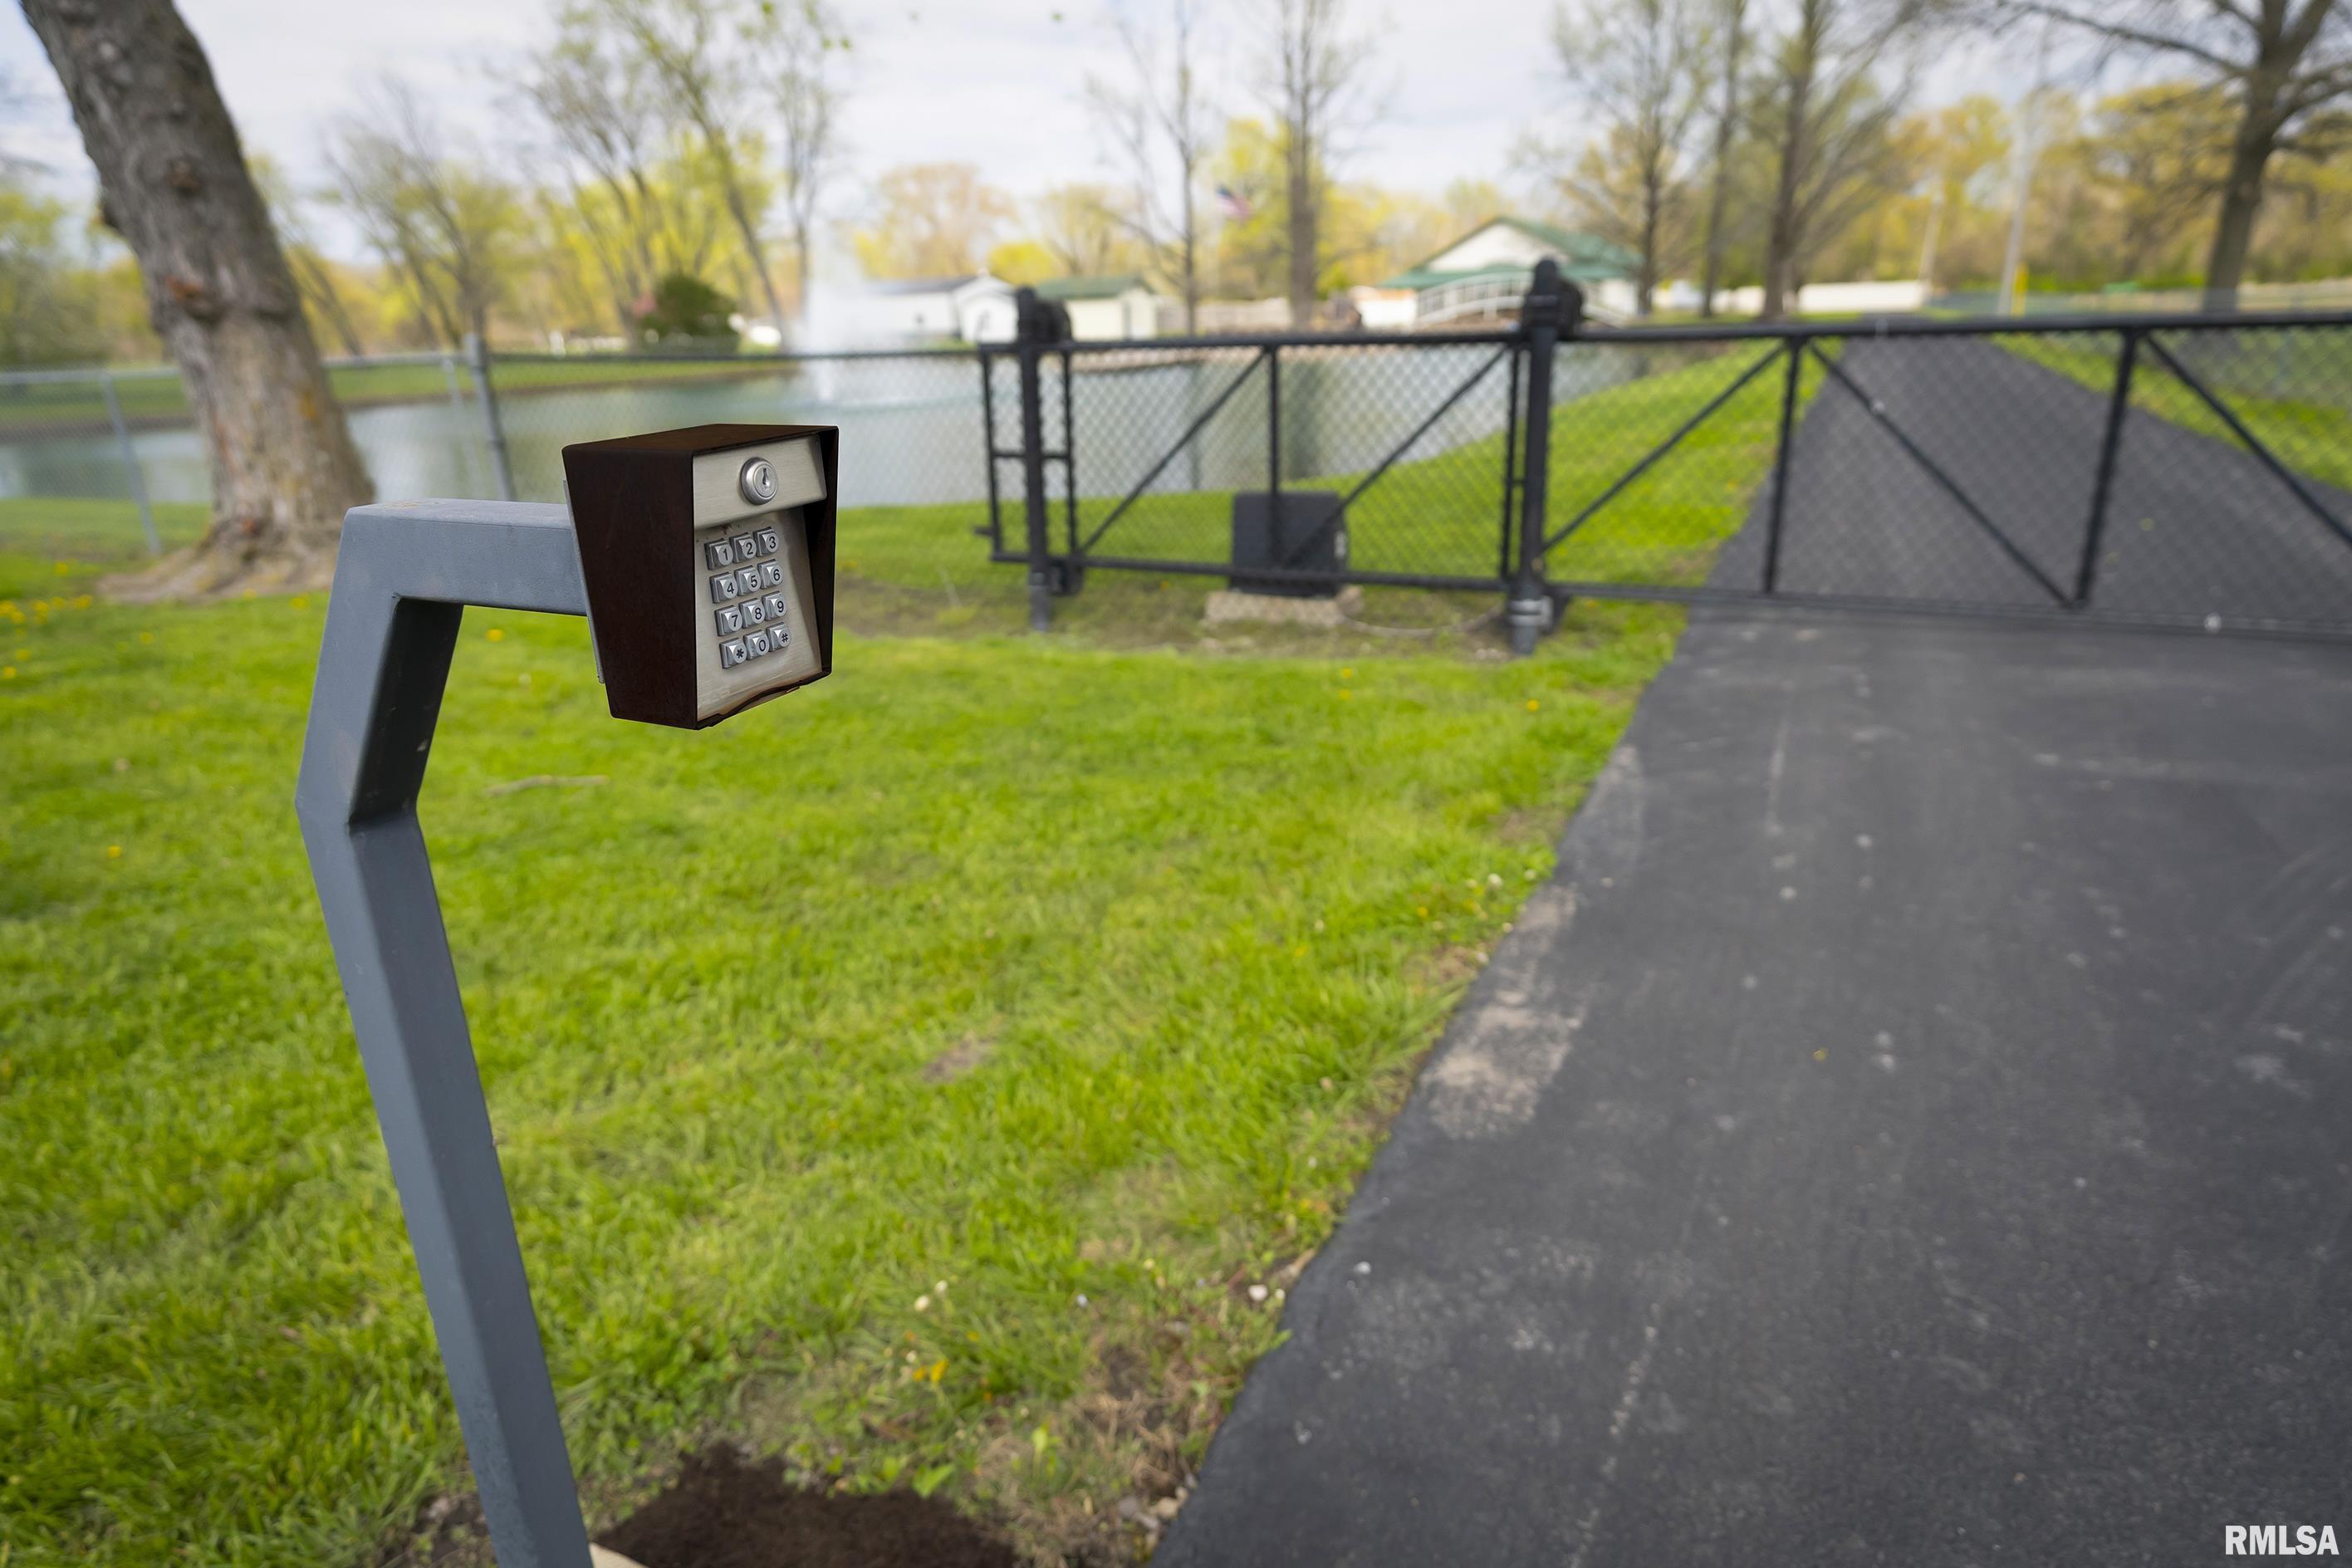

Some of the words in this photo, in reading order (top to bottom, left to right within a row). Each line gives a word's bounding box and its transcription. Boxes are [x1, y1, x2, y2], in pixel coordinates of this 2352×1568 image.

[723, 548, 729, 561] 1
[746, 542, 753, 556] 2
[769, 536, 777, 549] 3
[727, 582, 734, 594] 4
[750, 575, 757, 588] 5
[773, 569, 781, 581] 6
[731, 615, 738, 627] 7
[755, 607, 762, 620] 8
[777, 600, 784, 613] 9
[758, 639, 767, 652] 0
